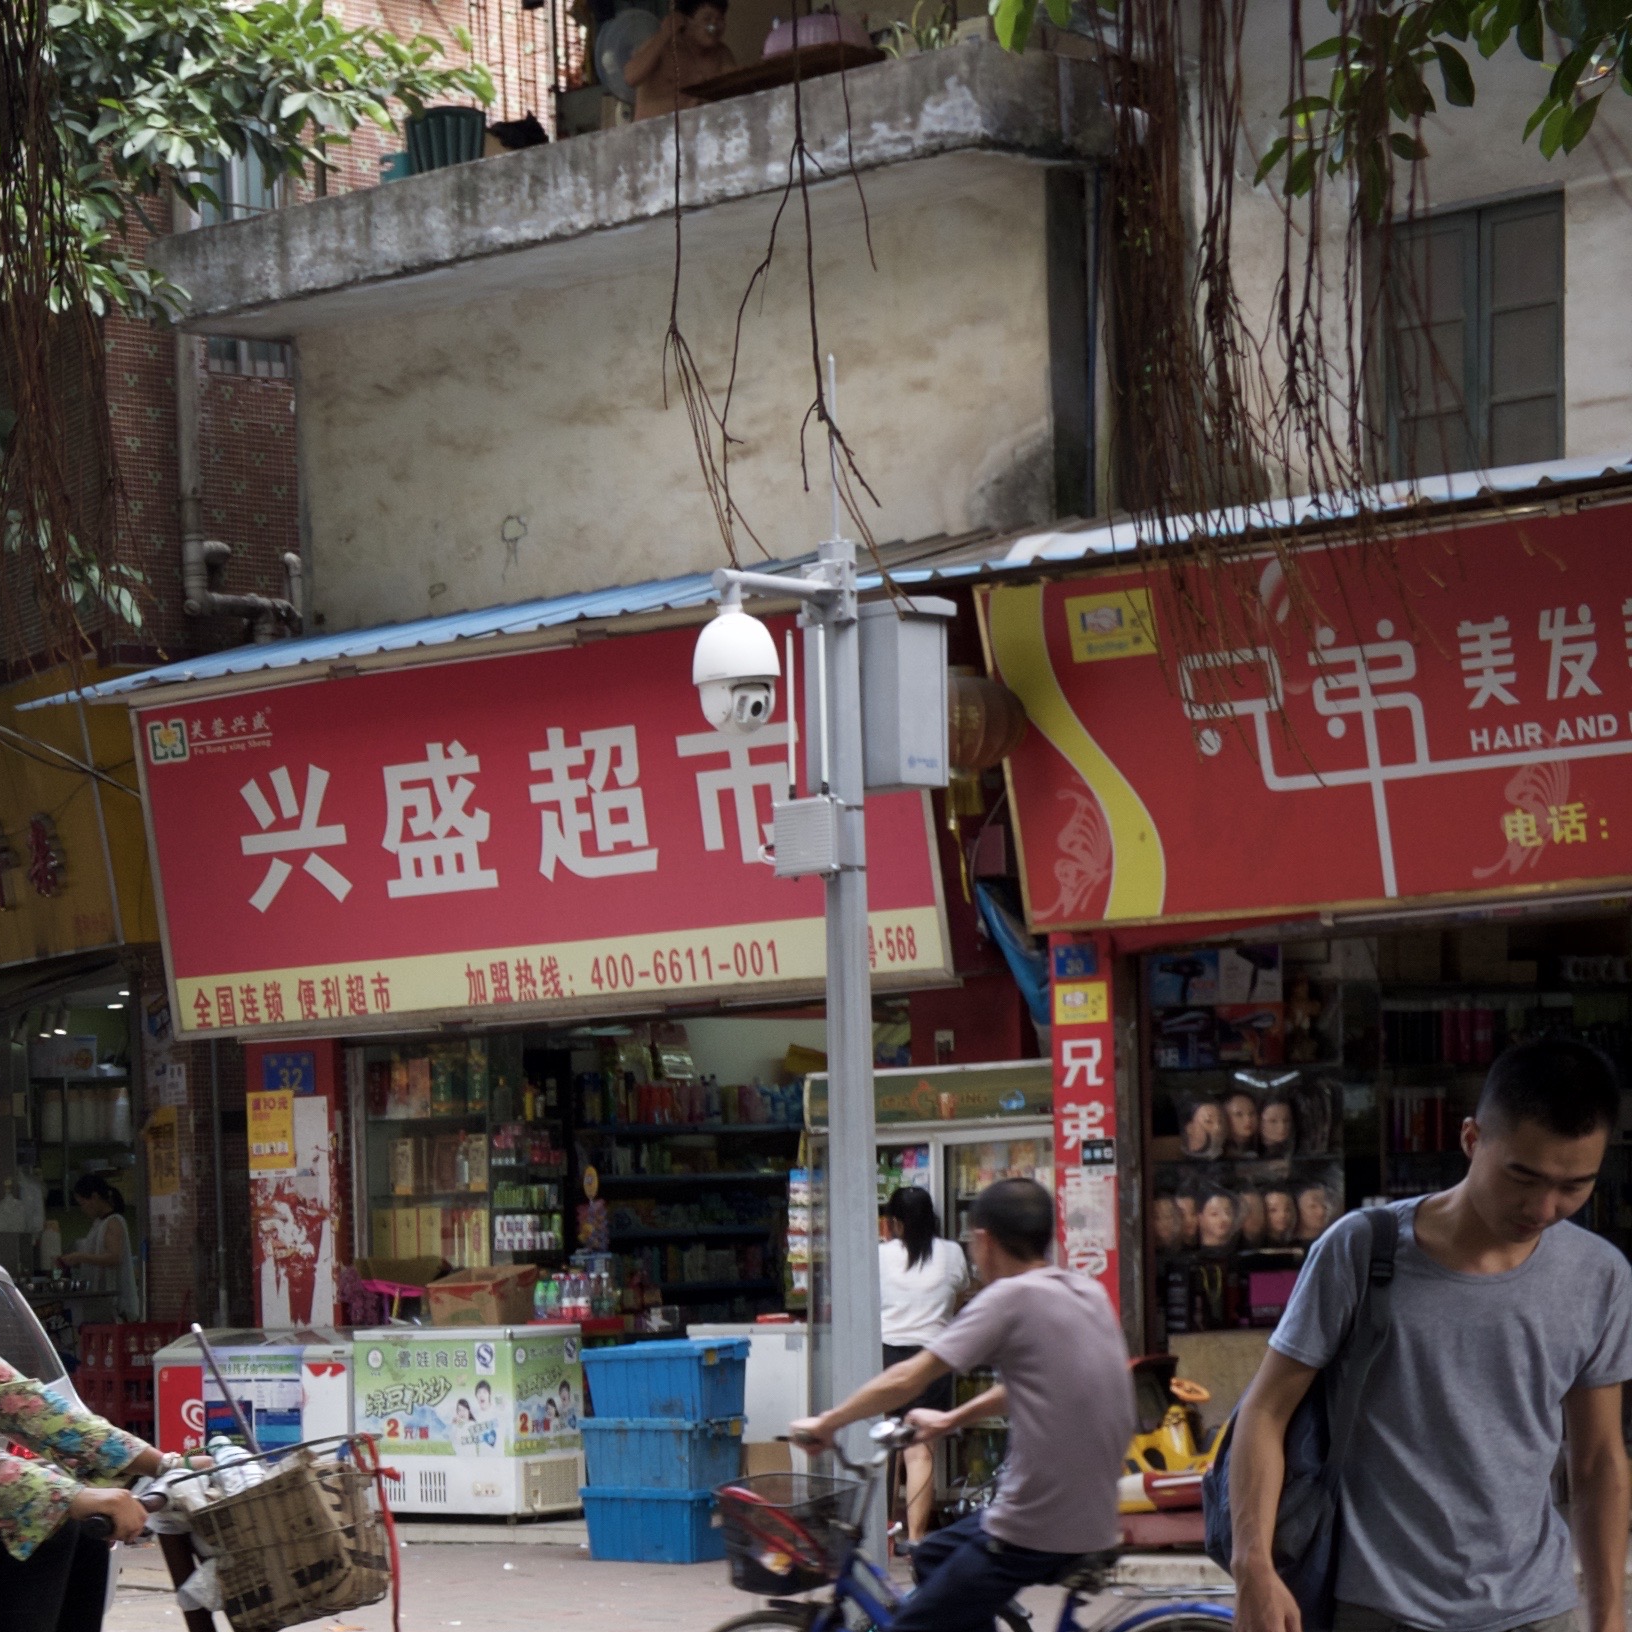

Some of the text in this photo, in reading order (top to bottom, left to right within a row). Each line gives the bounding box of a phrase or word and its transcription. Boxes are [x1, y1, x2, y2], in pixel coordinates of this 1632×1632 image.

[191, 711, 269, 739] 芙蓉兴盛
[1470, 713, 1618, 752] HAIR AND
[206, 744, 227, 754] Rong
[248, 739, 271, 749] Sheng
[1178, 598, 1632, 898] 兄弟 美发
[239, 720, 798, 913] 兴盛超市
[193, 980, 285, 1028] 全国连锁
[297, 971, 391, 1021] 便利超市
[465, 955, 575, 1007] 加盟热线：
[591, 939, 780, 991] 400-6611-001
[279, 1067, 303, 1092] 32
[365, 1375, 452, 1418] 绿豆冰沙
